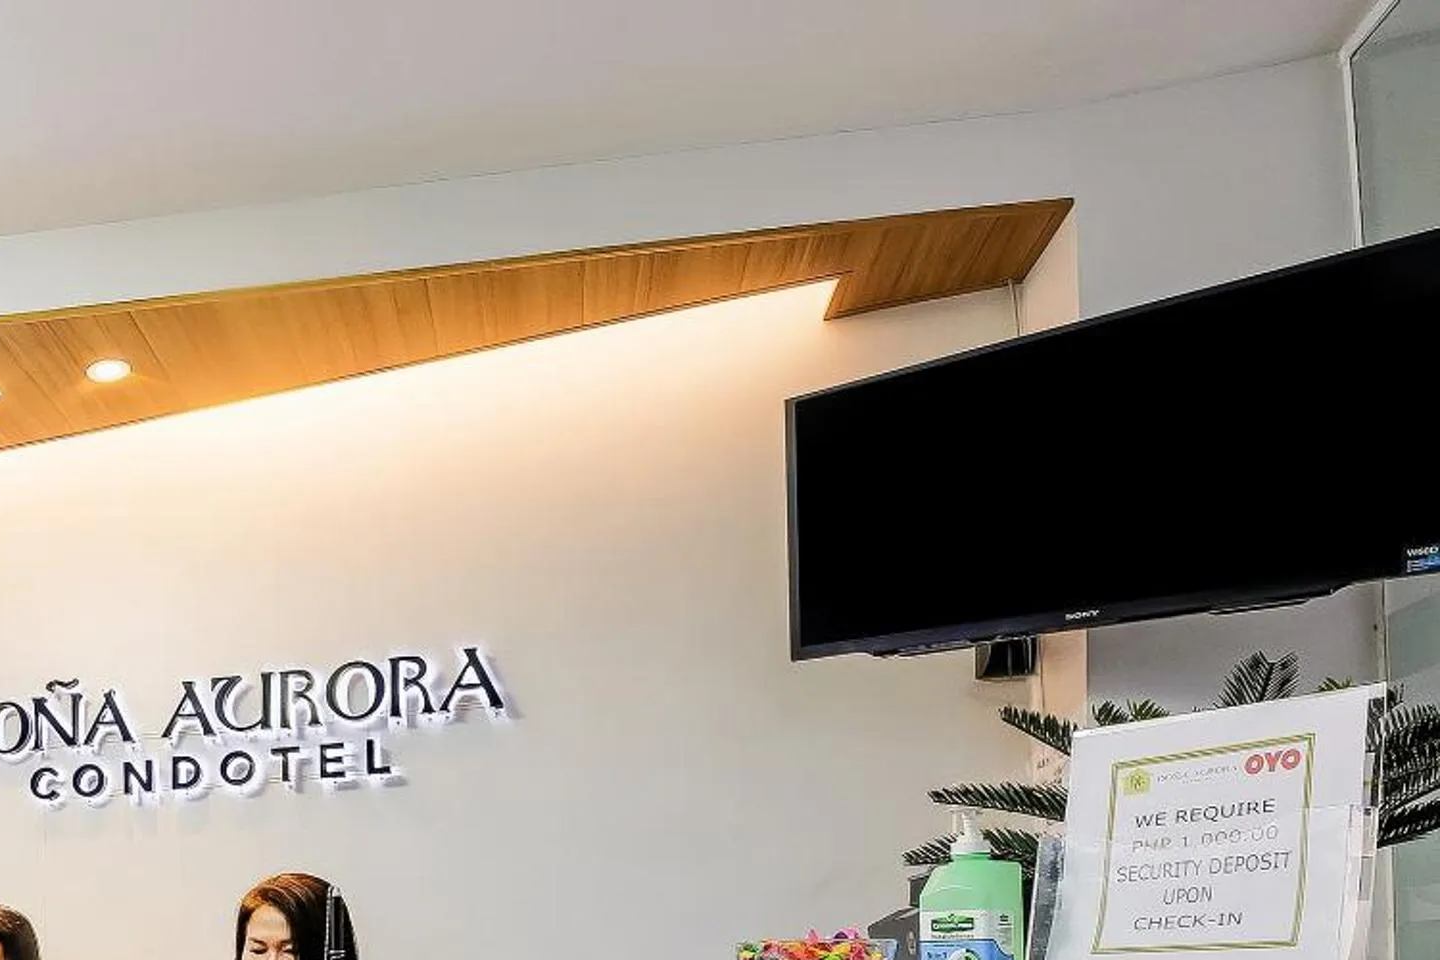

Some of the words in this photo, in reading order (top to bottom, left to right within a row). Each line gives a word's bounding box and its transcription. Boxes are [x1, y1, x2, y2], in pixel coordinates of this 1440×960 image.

[161, 647, 505, 739] AURORA
[30, 739, 391, 800] CONDOTEL
[1244, 749, 1301, 775] OYO
[1135, 812, 1166, 828] WE
[1175, 799, 1275, 824] REQUIRE
[1117, 859, 1202, 883] SECURITY
[1210, 852, 1293, 875] DEPOSIT
[1163, 886, 1213, 905] UPON
[1134, 912, 1243, 931] CHECK-IN
